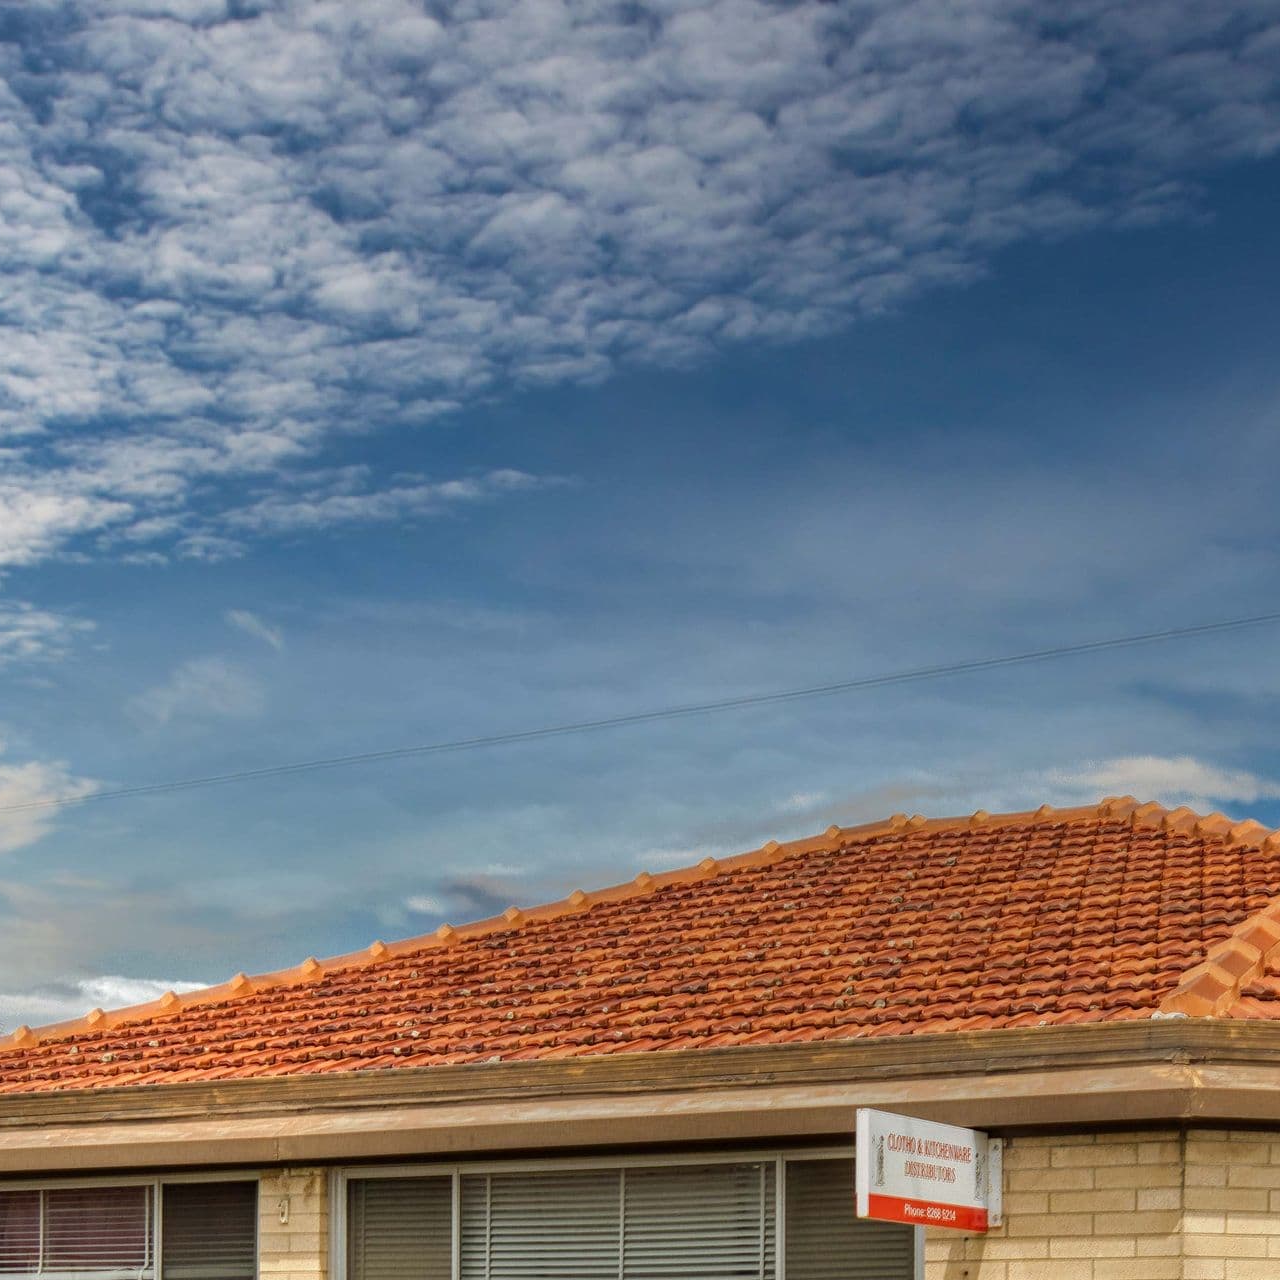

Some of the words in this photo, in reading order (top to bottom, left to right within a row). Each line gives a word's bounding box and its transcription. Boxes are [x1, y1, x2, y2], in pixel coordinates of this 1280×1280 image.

[888, 1133, 916, 1154] CLOTHO
[917, 1138, 924, 1156] &
[924, 1139, 972, 1163] KITCHENWARE
[904, 1203, 926, 1218] Phone:
[926, 1205, 942, 1219] 8268
[942, 1207, 956, 1221] 5214
